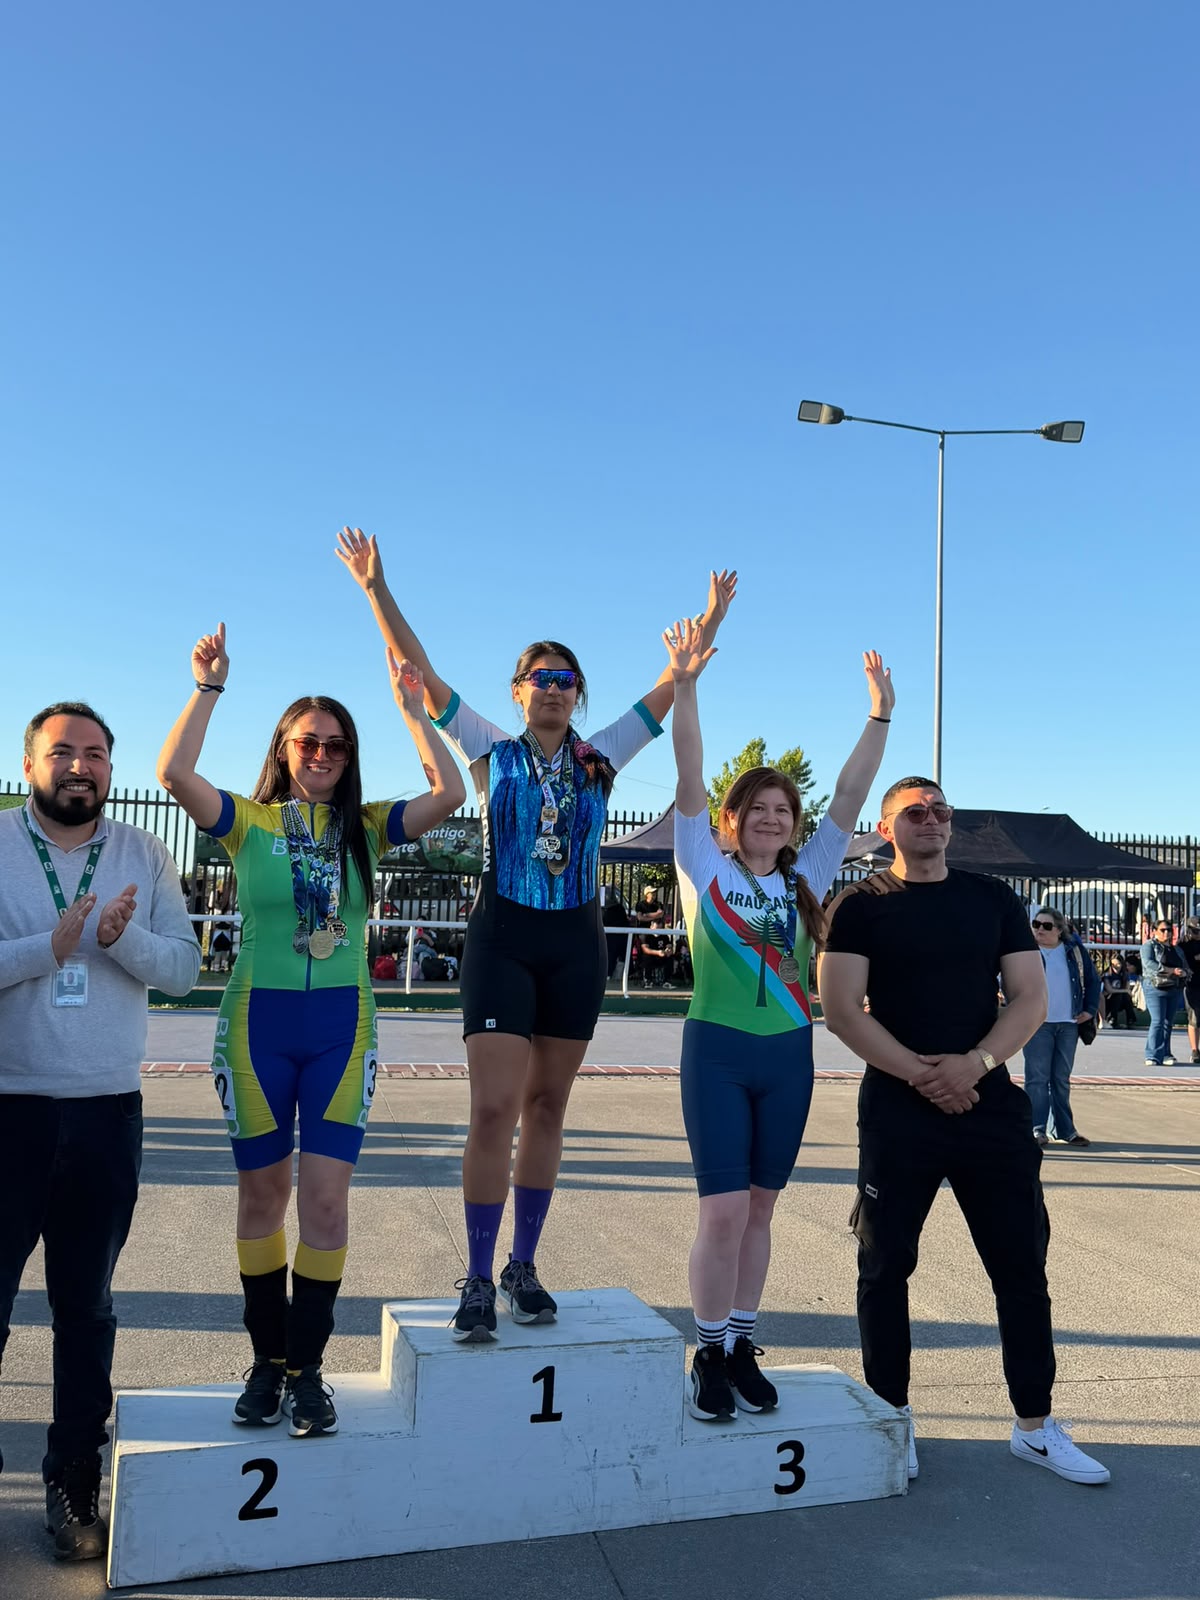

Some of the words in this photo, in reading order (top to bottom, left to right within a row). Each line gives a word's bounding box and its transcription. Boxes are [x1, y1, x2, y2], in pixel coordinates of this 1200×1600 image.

[420, 826, 466, 840] ontigo
[478, 791, 490, 873] MAULE
[530, 1366, 562, 1423] 1
[238, 1457, 279, 1521] 2
[775, 1440, 805, 1494] 3
